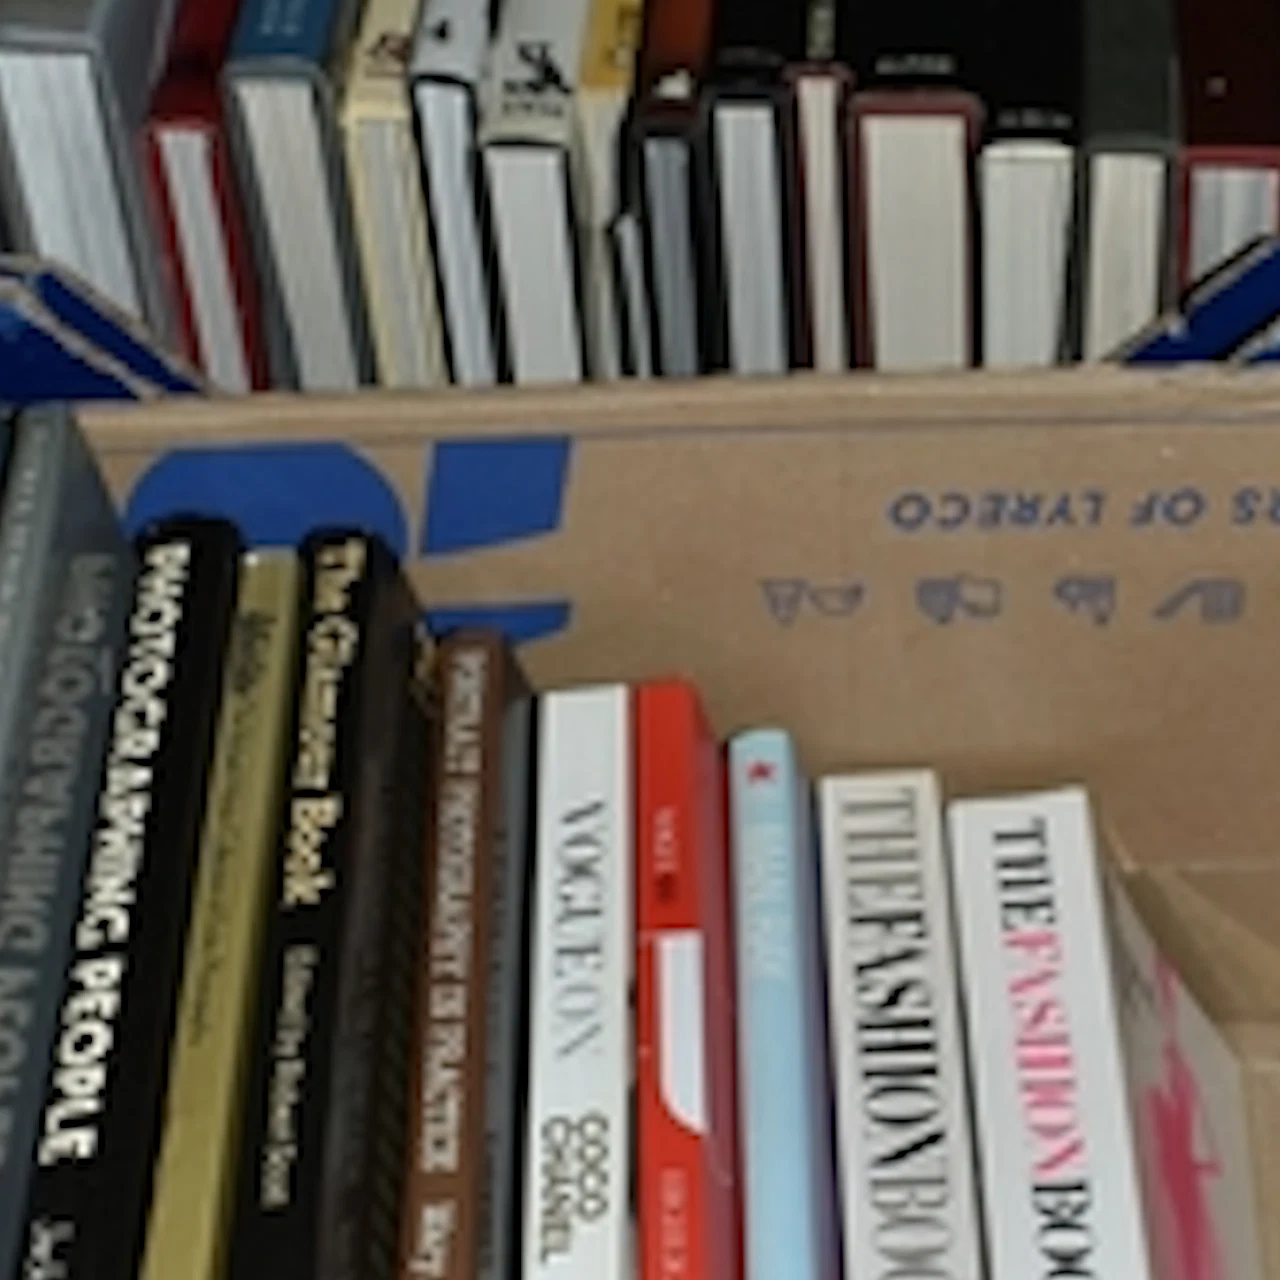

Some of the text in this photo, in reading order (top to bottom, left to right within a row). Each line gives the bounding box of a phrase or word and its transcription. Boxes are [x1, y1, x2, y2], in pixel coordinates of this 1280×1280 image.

[886, 489, 1107, 532] LYRECO
[1129, 490, 1207, 528] OF
[76, 537, 192, 951] PHOTOGRAPHING
[280, 537, 368, 911] The Glamour Book
[429, 775, 485, 980] PHOTOGRAPHY
[36, 951, 124, 1169] PEOPLE
[426, 982, 472, 1020] IN
[419, 1021, 469, 1174] PRACTICE
[576, 1114, 610, 1220] COCO
[540, 1114, 574, 1265] CHANEL
